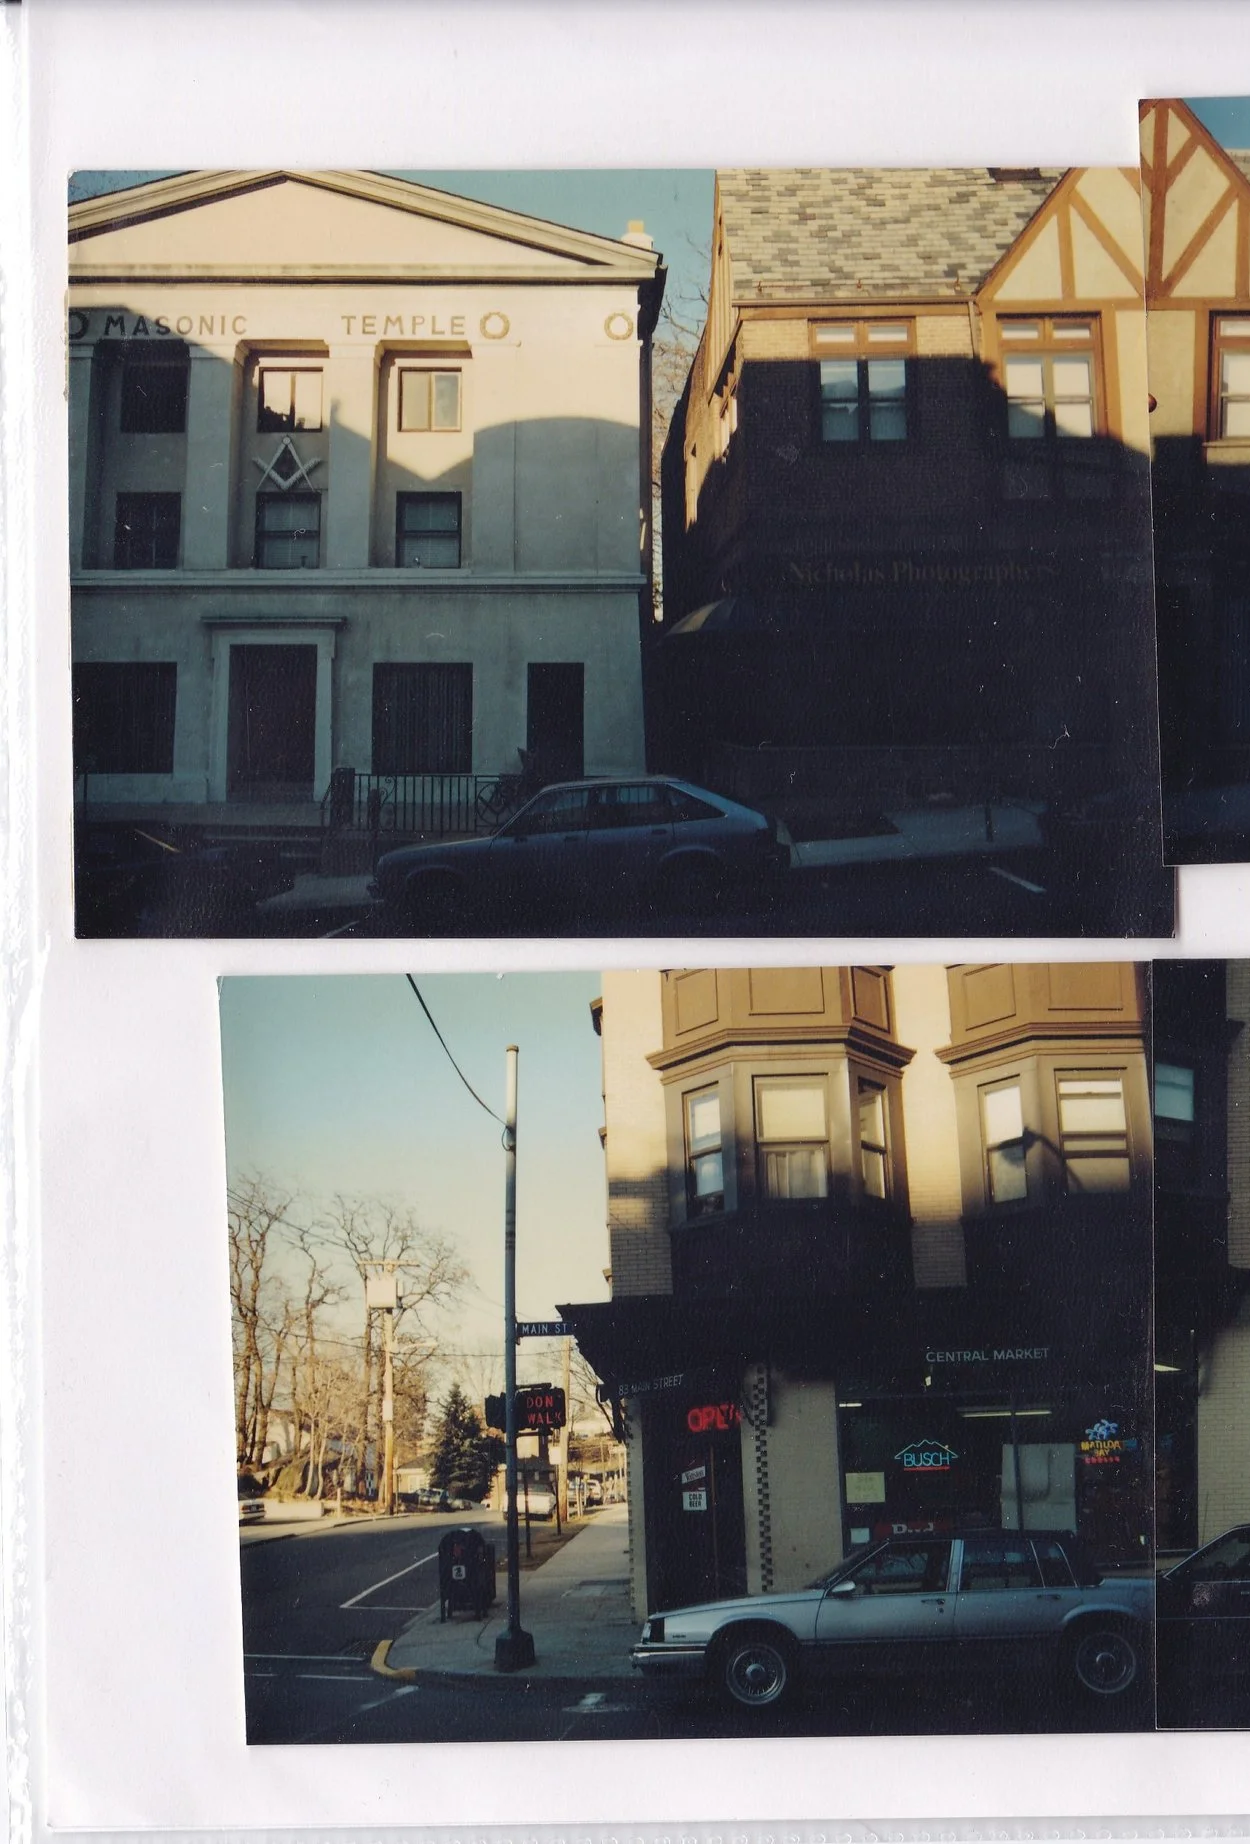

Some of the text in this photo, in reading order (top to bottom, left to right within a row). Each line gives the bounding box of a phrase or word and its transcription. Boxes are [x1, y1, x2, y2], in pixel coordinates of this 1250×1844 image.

[103, 314, 467, 336] MASONIC TEMPLE
[522, 1323, 567, 1334] MAIN ST
[925, 1347, 1049, 1363] CENTRAL MARKET
[653, 1373, 684, 1390] STREET
[527, 1411, 562, 1425] WALK
[903, 1453, 951, 1467] BUSCH
[688, 1493, 703, 1501] COLD
